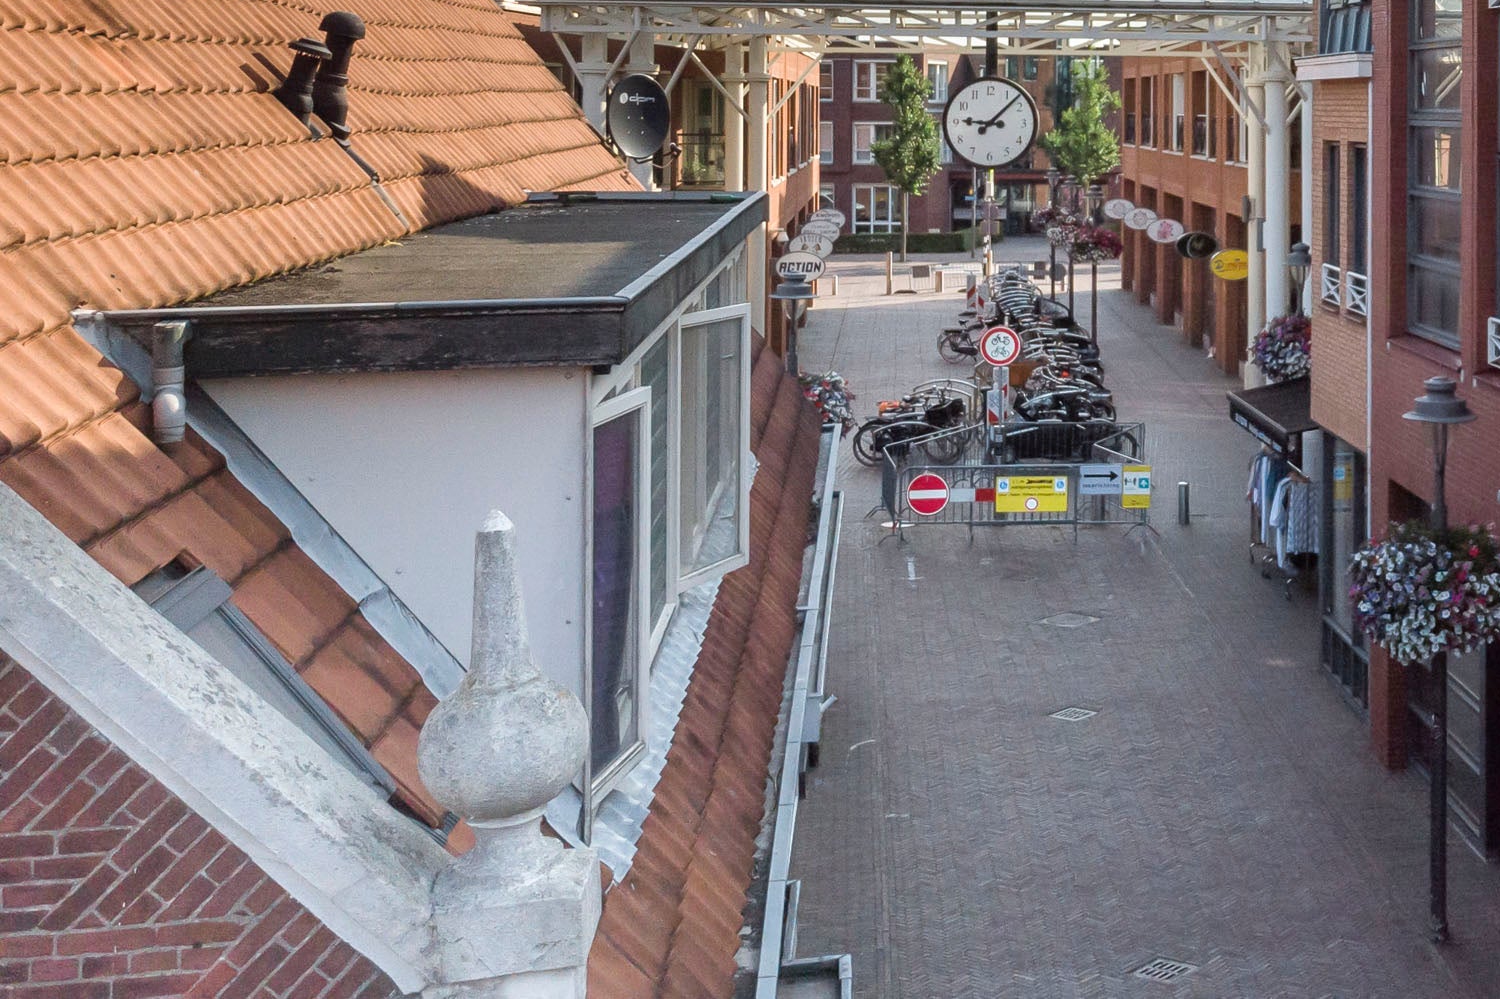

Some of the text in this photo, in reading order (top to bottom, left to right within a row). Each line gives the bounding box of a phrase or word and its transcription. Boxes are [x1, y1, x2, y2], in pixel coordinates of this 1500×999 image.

[971, 90, 978, 99] 11
[986, 86, 995, 96] 12
[959, 101, 968, 111] 10
[1016, 102, 1023, 112] 2
[953, 118, 959, 127] 9
[1021, 119, 1027, 128] 3
[957, 135, 963, 144] 8
[1015, 136, 1022, 145] 4
[969, 147, 975, 155] 7
[1003, 147, 1010, 157] 5
[986, 152, 992, 161] 6
[779, 261, 822, 273] ACTION
